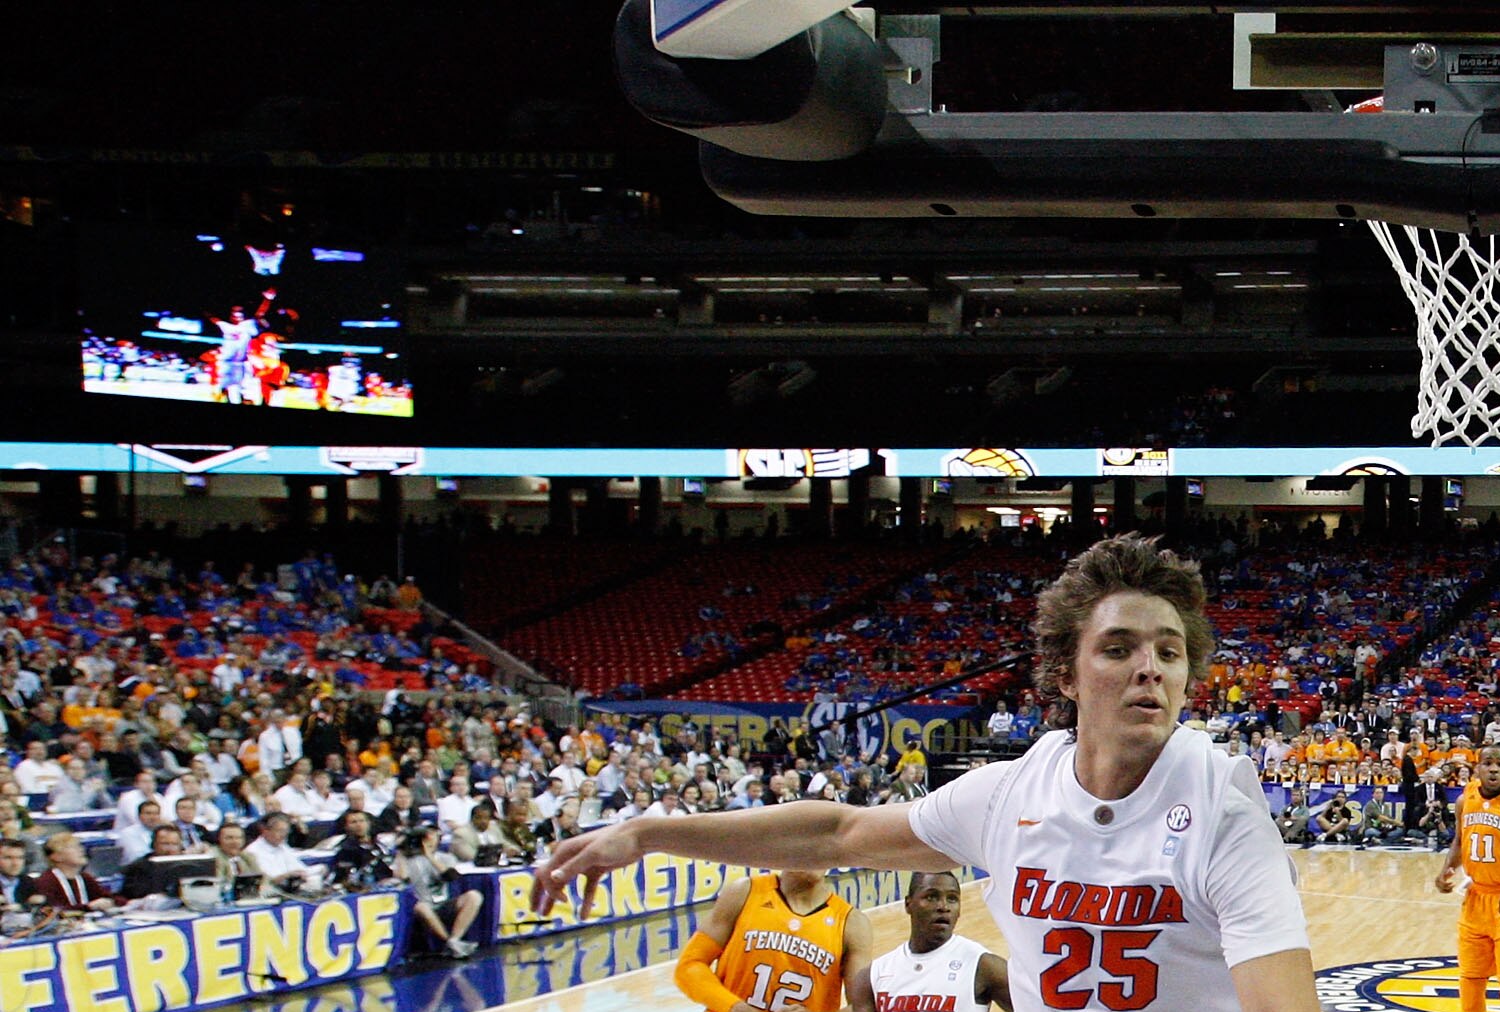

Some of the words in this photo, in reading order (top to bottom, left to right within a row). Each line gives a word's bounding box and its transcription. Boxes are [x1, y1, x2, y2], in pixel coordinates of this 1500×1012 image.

[1469, 832, 1496, 863] 11
[1012, 866, 1190, 927] FLORIDA
[743, 929, 836, 976] TENNESSEE
[1039, 926, 1164, 1012] 25
[746, 962, 814, 1012] 12
